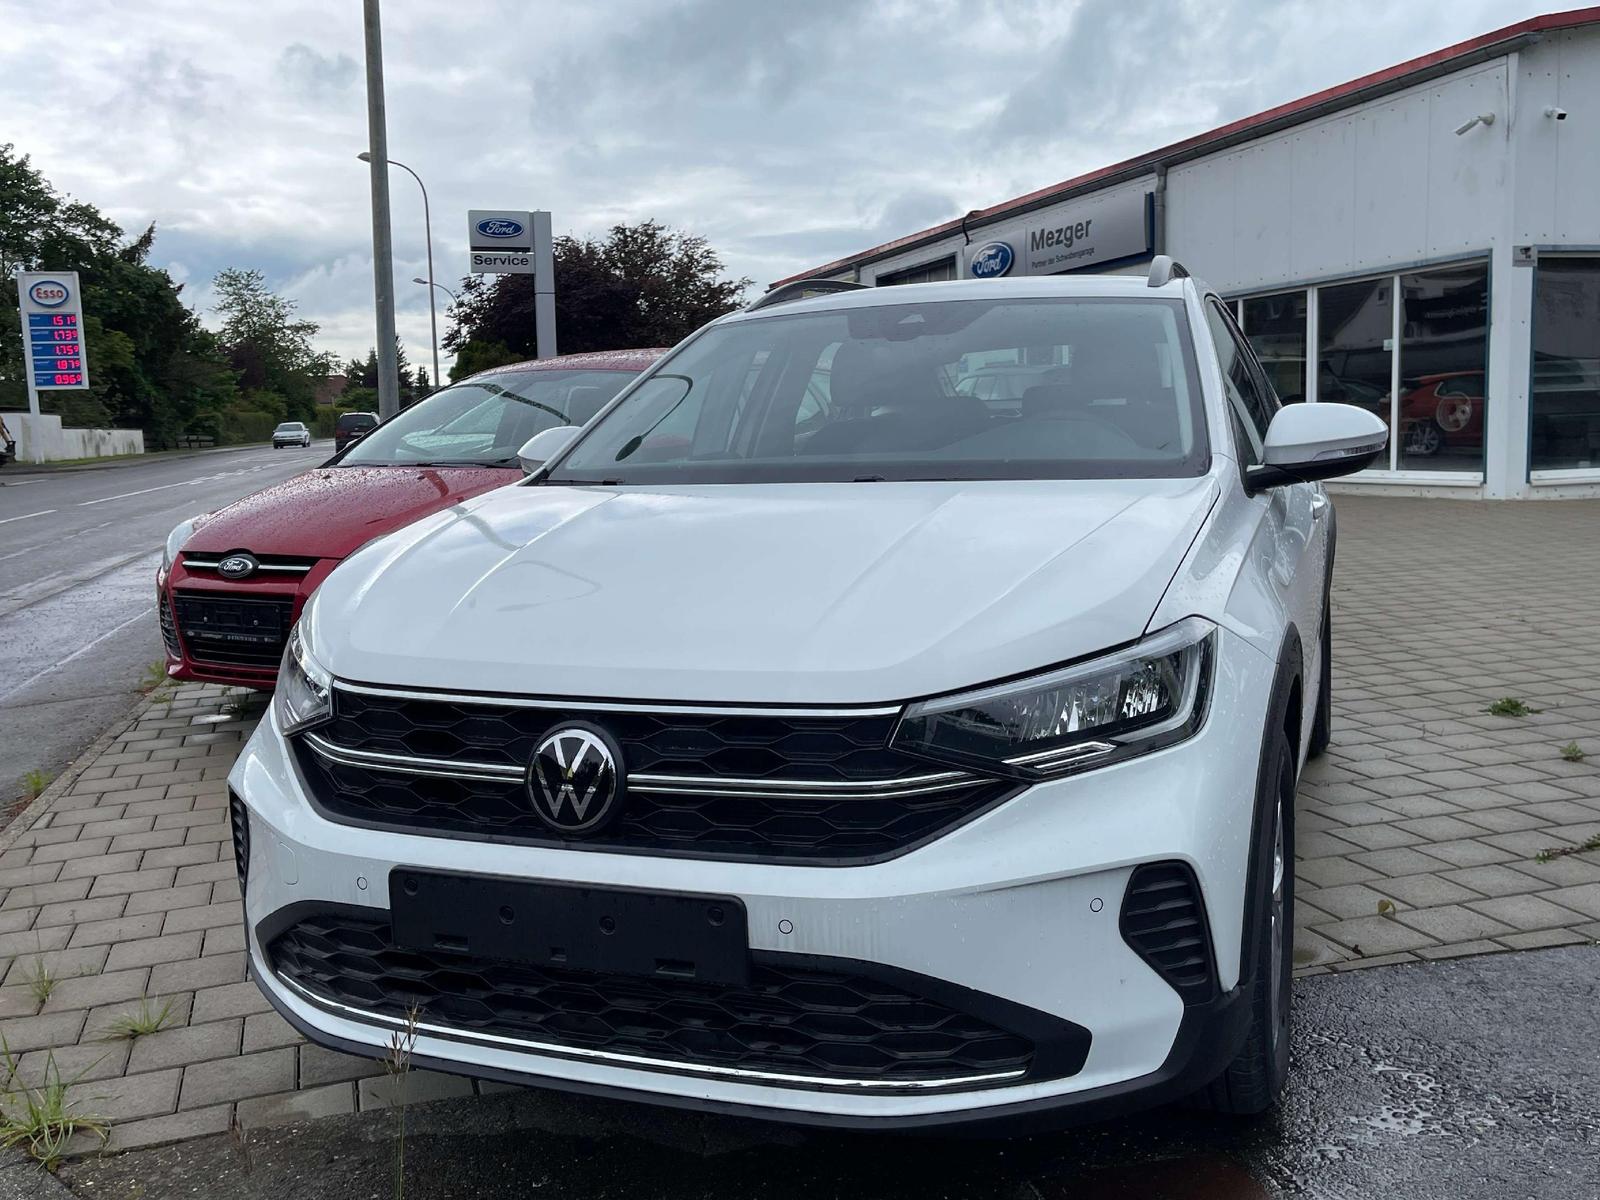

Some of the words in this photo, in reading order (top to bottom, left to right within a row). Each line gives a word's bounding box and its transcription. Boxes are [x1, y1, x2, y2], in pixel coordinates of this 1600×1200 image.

[486, 221, 515, 234] Ford
[1031, 218, 1093, 252] Mezger
[473, 255, 529, 266] Service
[976, 249, 1003, 273] Ford
[35, 287, 64, 299] Esso
[222, 560, 244, 571] Ford
